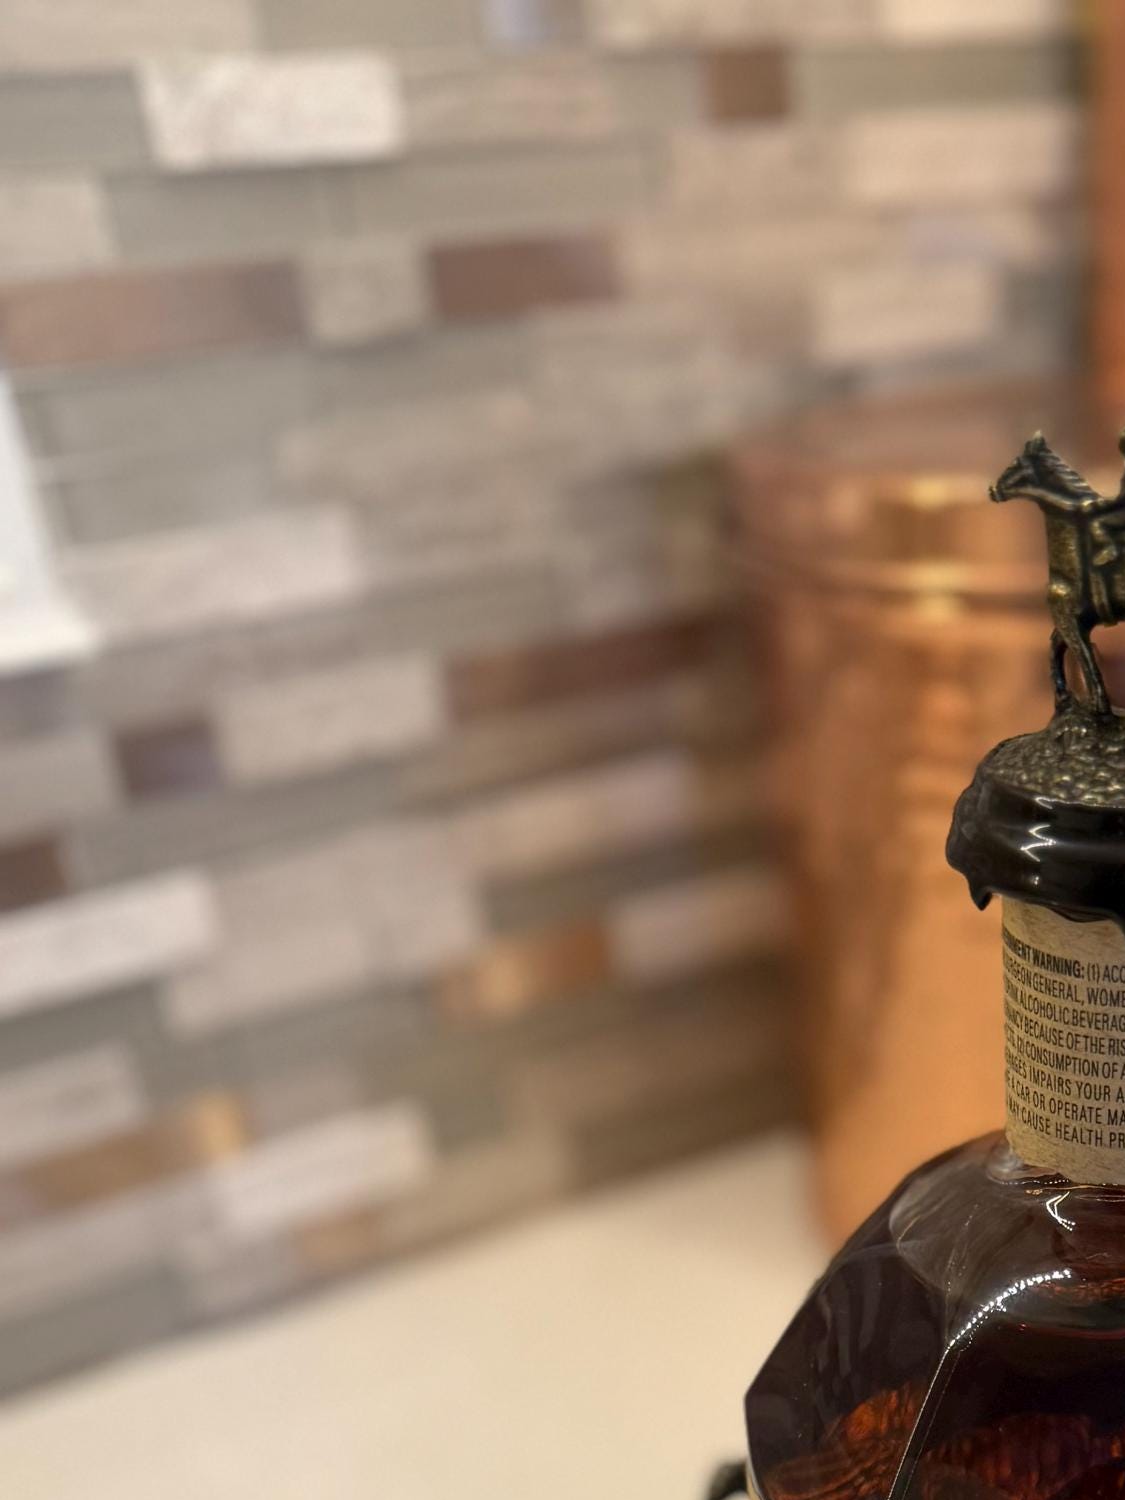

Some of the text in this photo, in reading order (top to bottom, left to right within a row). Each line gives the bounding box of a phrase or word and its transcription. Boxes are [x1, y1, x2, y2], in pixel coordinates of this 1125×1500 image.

[1033, 947, 1085, 979] WARNING:
[1087, 962, 1100, 984] (1)
[1020, 990, 1071, 1025] ALCOHOLIC
[1033, 972, 1085, 1006] GENERAL,
[1024, 1015, 1064, 1048] BECAUSE
[1066, 1032, 1081, 1052] OF
[1083, 1034, 1105, 1055] THE
[1025, 1040, 1099, 1078] CONSUMPTION
[1102, 1061, 1118, 1080] OF
[1016, 1080, 1031, 1105] CAR
[1033, 1090, 1046, 1112] OR
[1049, 1097, 1103, 1125] OPERATE
[1029, 1065, 1072, 1096] IMPAIRS
[1075, 1080, 1111, 1103] YOUR
[1021, 1106, 1050, 1136] CAUSE
[1055, 1121, 1103, 1148] HEALTH
